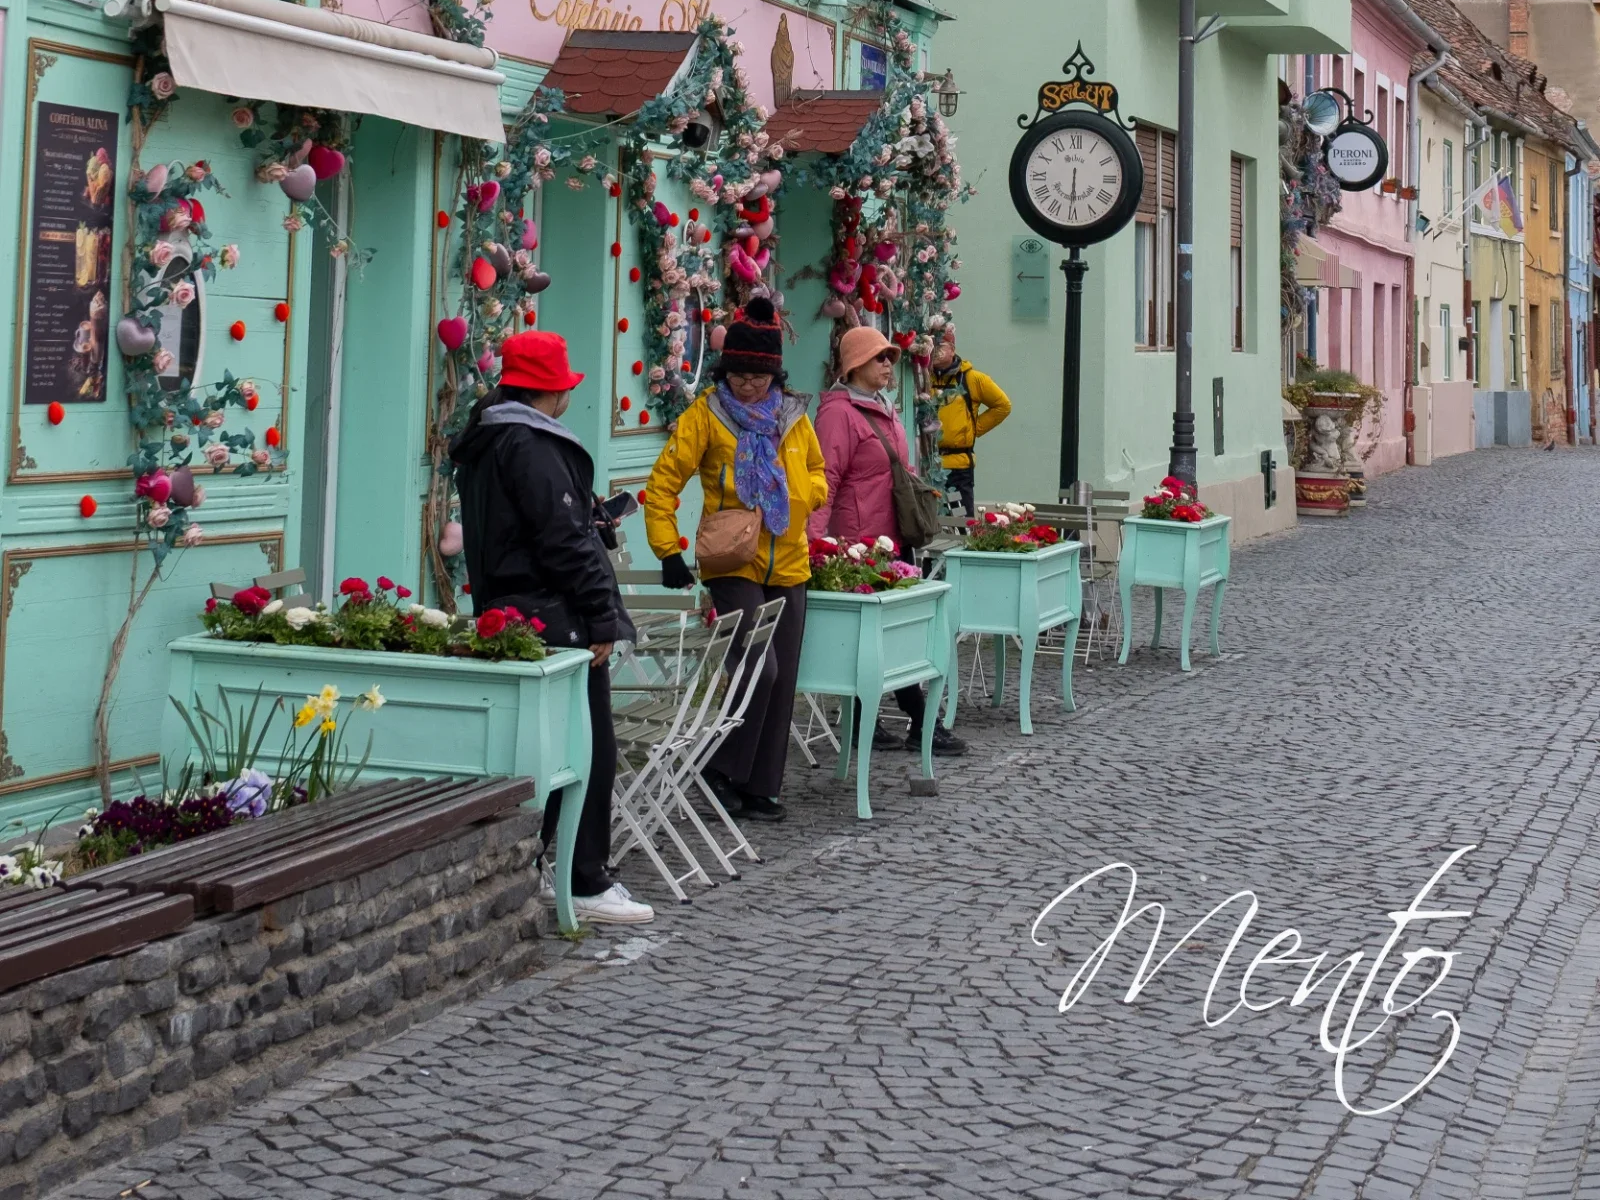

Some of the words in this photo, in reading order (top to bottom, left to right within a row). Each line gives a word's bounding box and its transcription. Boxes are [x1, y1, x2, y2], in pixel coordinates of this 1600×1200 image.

[1042, 81, 1113, 110] SALUT
[1069, 134, 1082, 150] XII
[1064, 154, 1085, 164] Sibiu
[1332, 148, 1373, 158] PERONI
